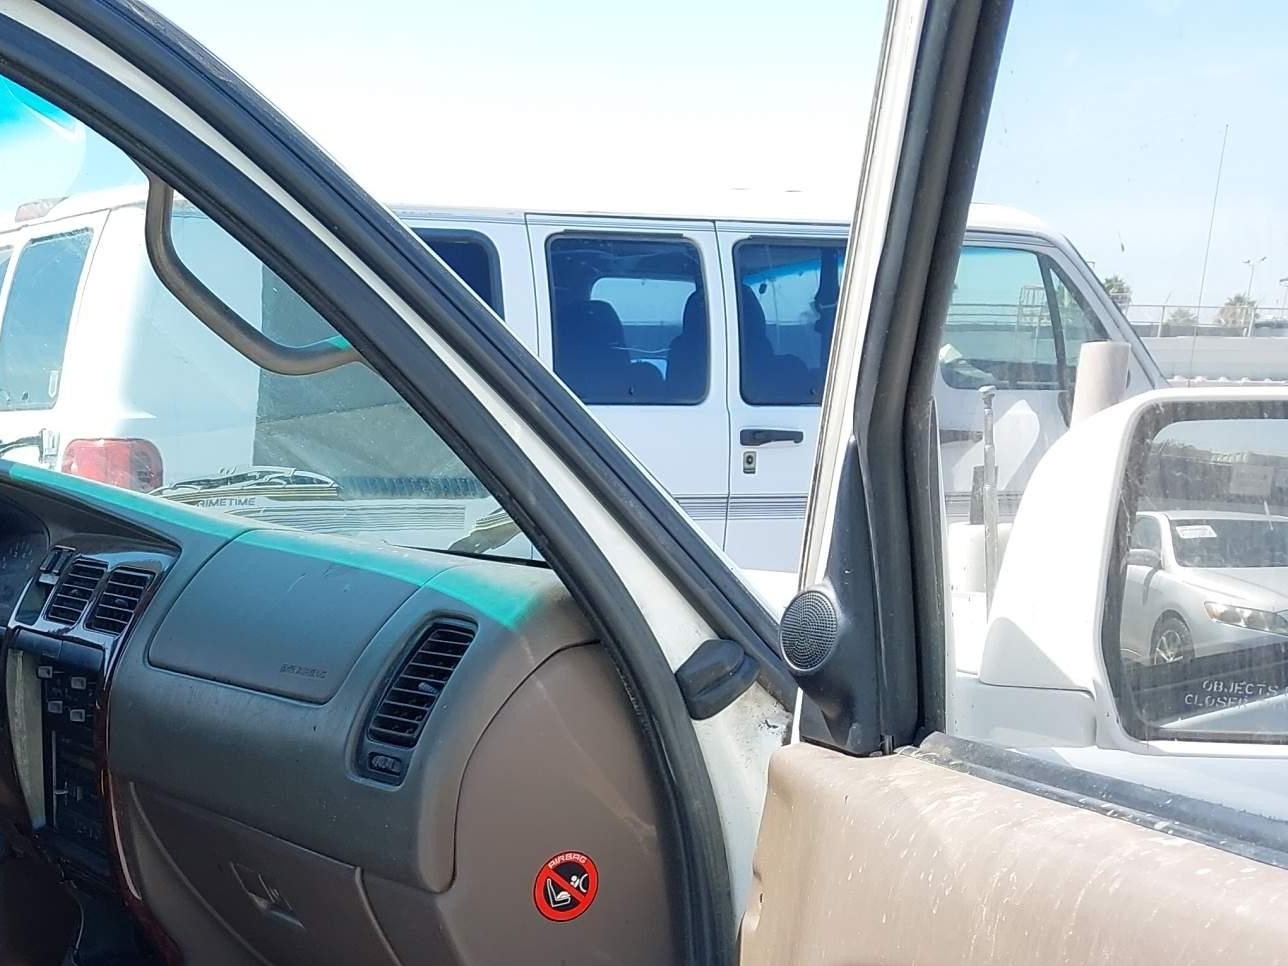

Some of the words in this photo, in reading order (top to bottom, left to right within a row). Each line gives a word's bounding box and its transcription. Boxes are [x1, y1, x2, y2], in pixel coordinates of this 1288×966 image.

[197, 497, 256, 508] RIMETIME
[1202, 680, 1279, 696] OBJECTS
[547, 853, 588, 869] AIRBAG
